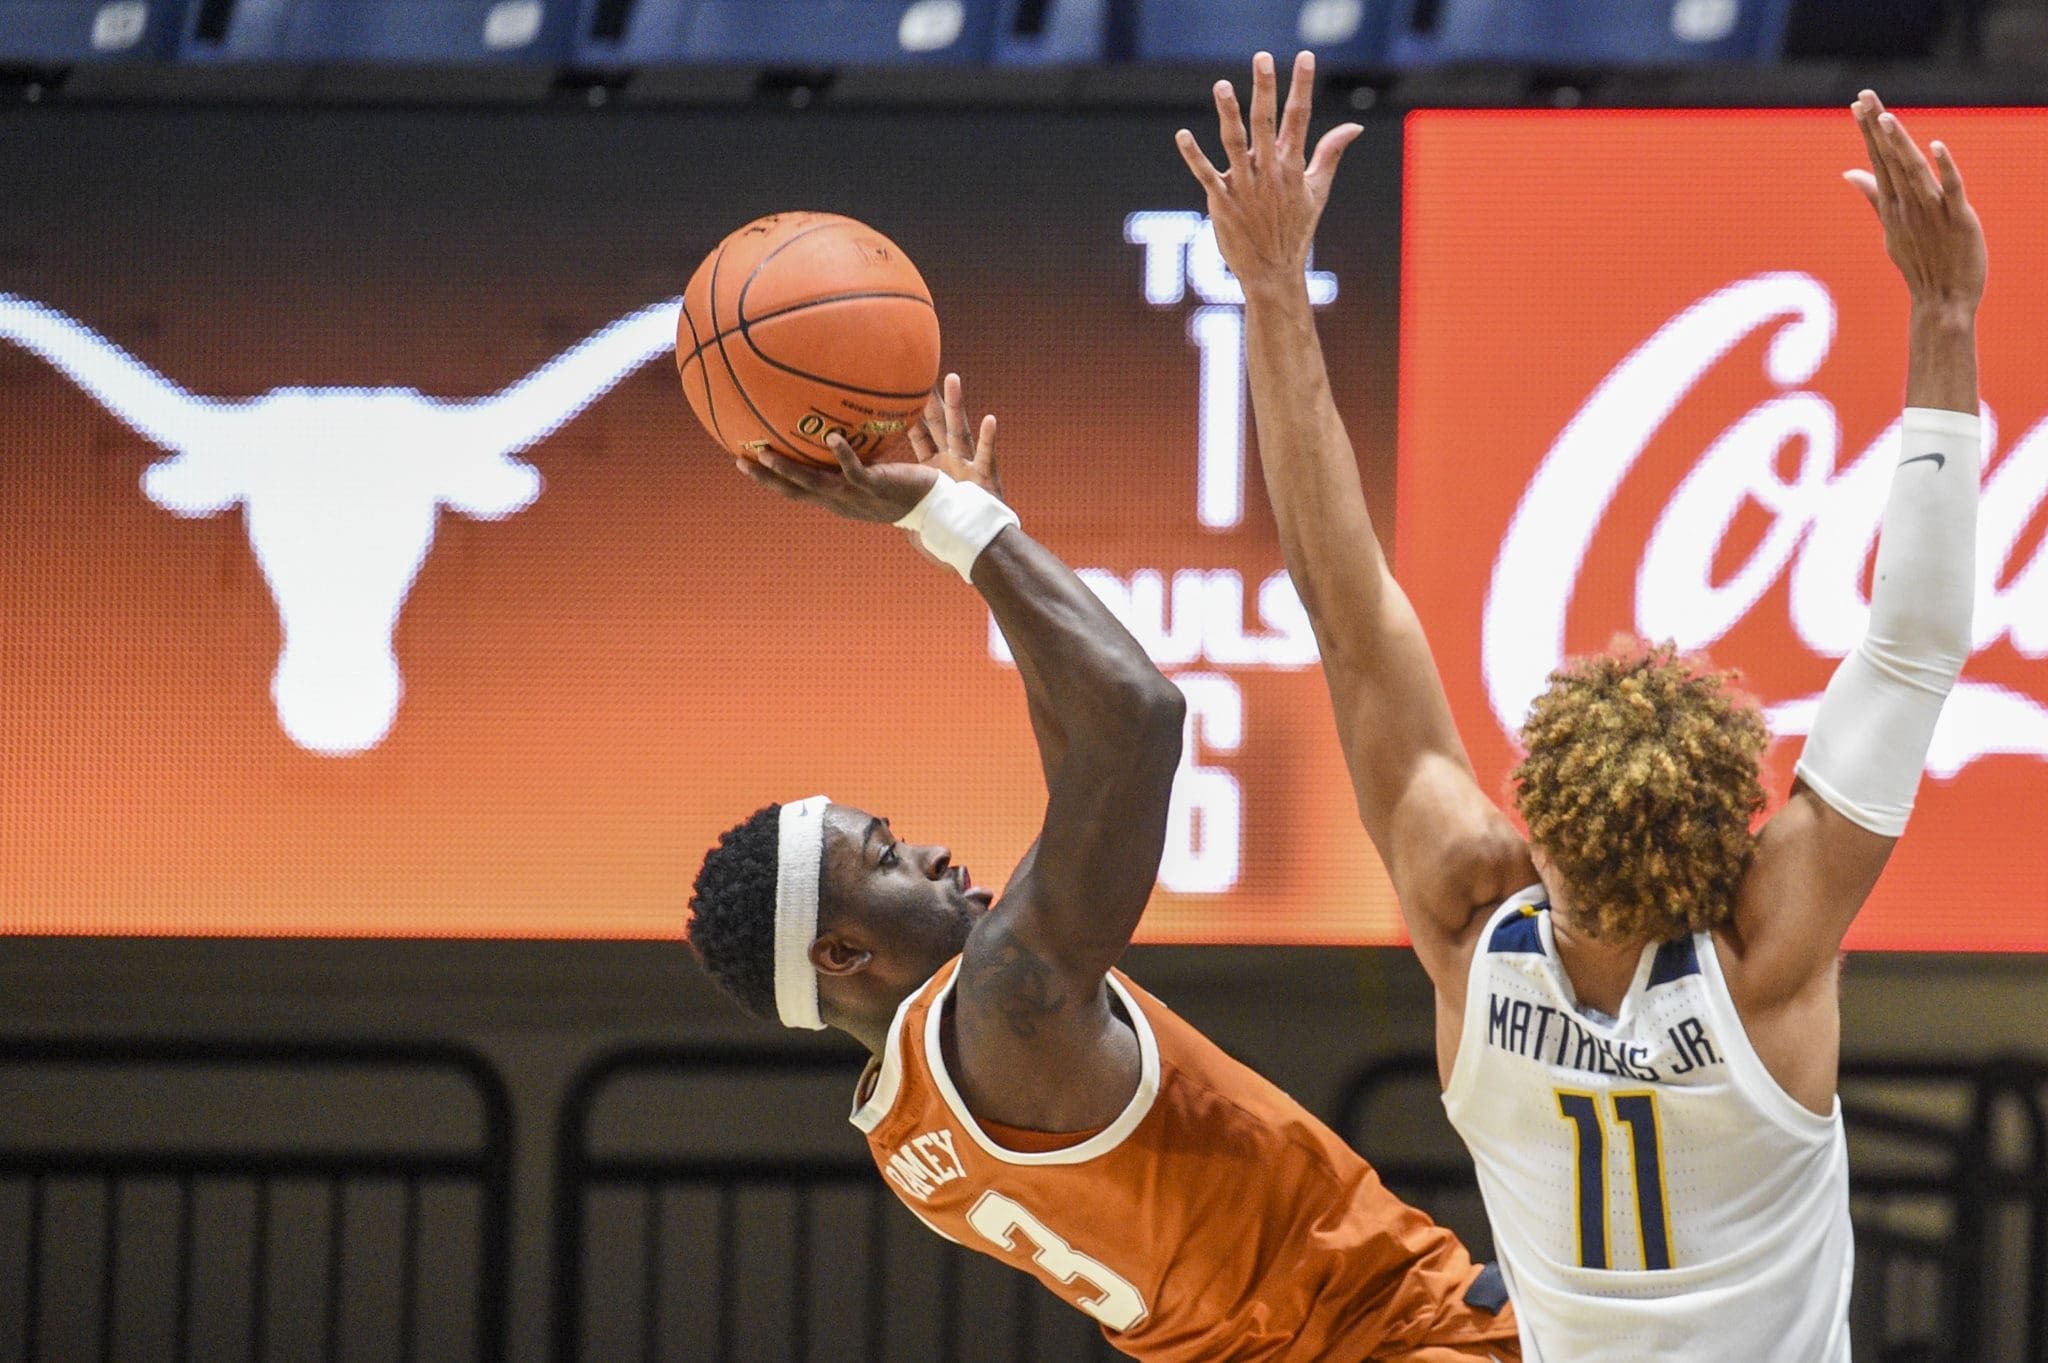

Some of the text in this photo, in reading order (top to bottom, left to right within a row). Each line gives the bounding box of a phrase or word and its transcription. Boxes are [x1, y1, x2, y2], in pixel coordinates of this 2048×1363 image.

[1191, 304, 1245, 528] 1
[987, 568, 1322, 671] ULS
[1156, 672, 1243, 894] 6
[1489, 992, 1724, 1082] MATTHEWS JR.
[1553, 1088, 1676, 1270] 11
[965, 1189, 1149, 1332] 3
